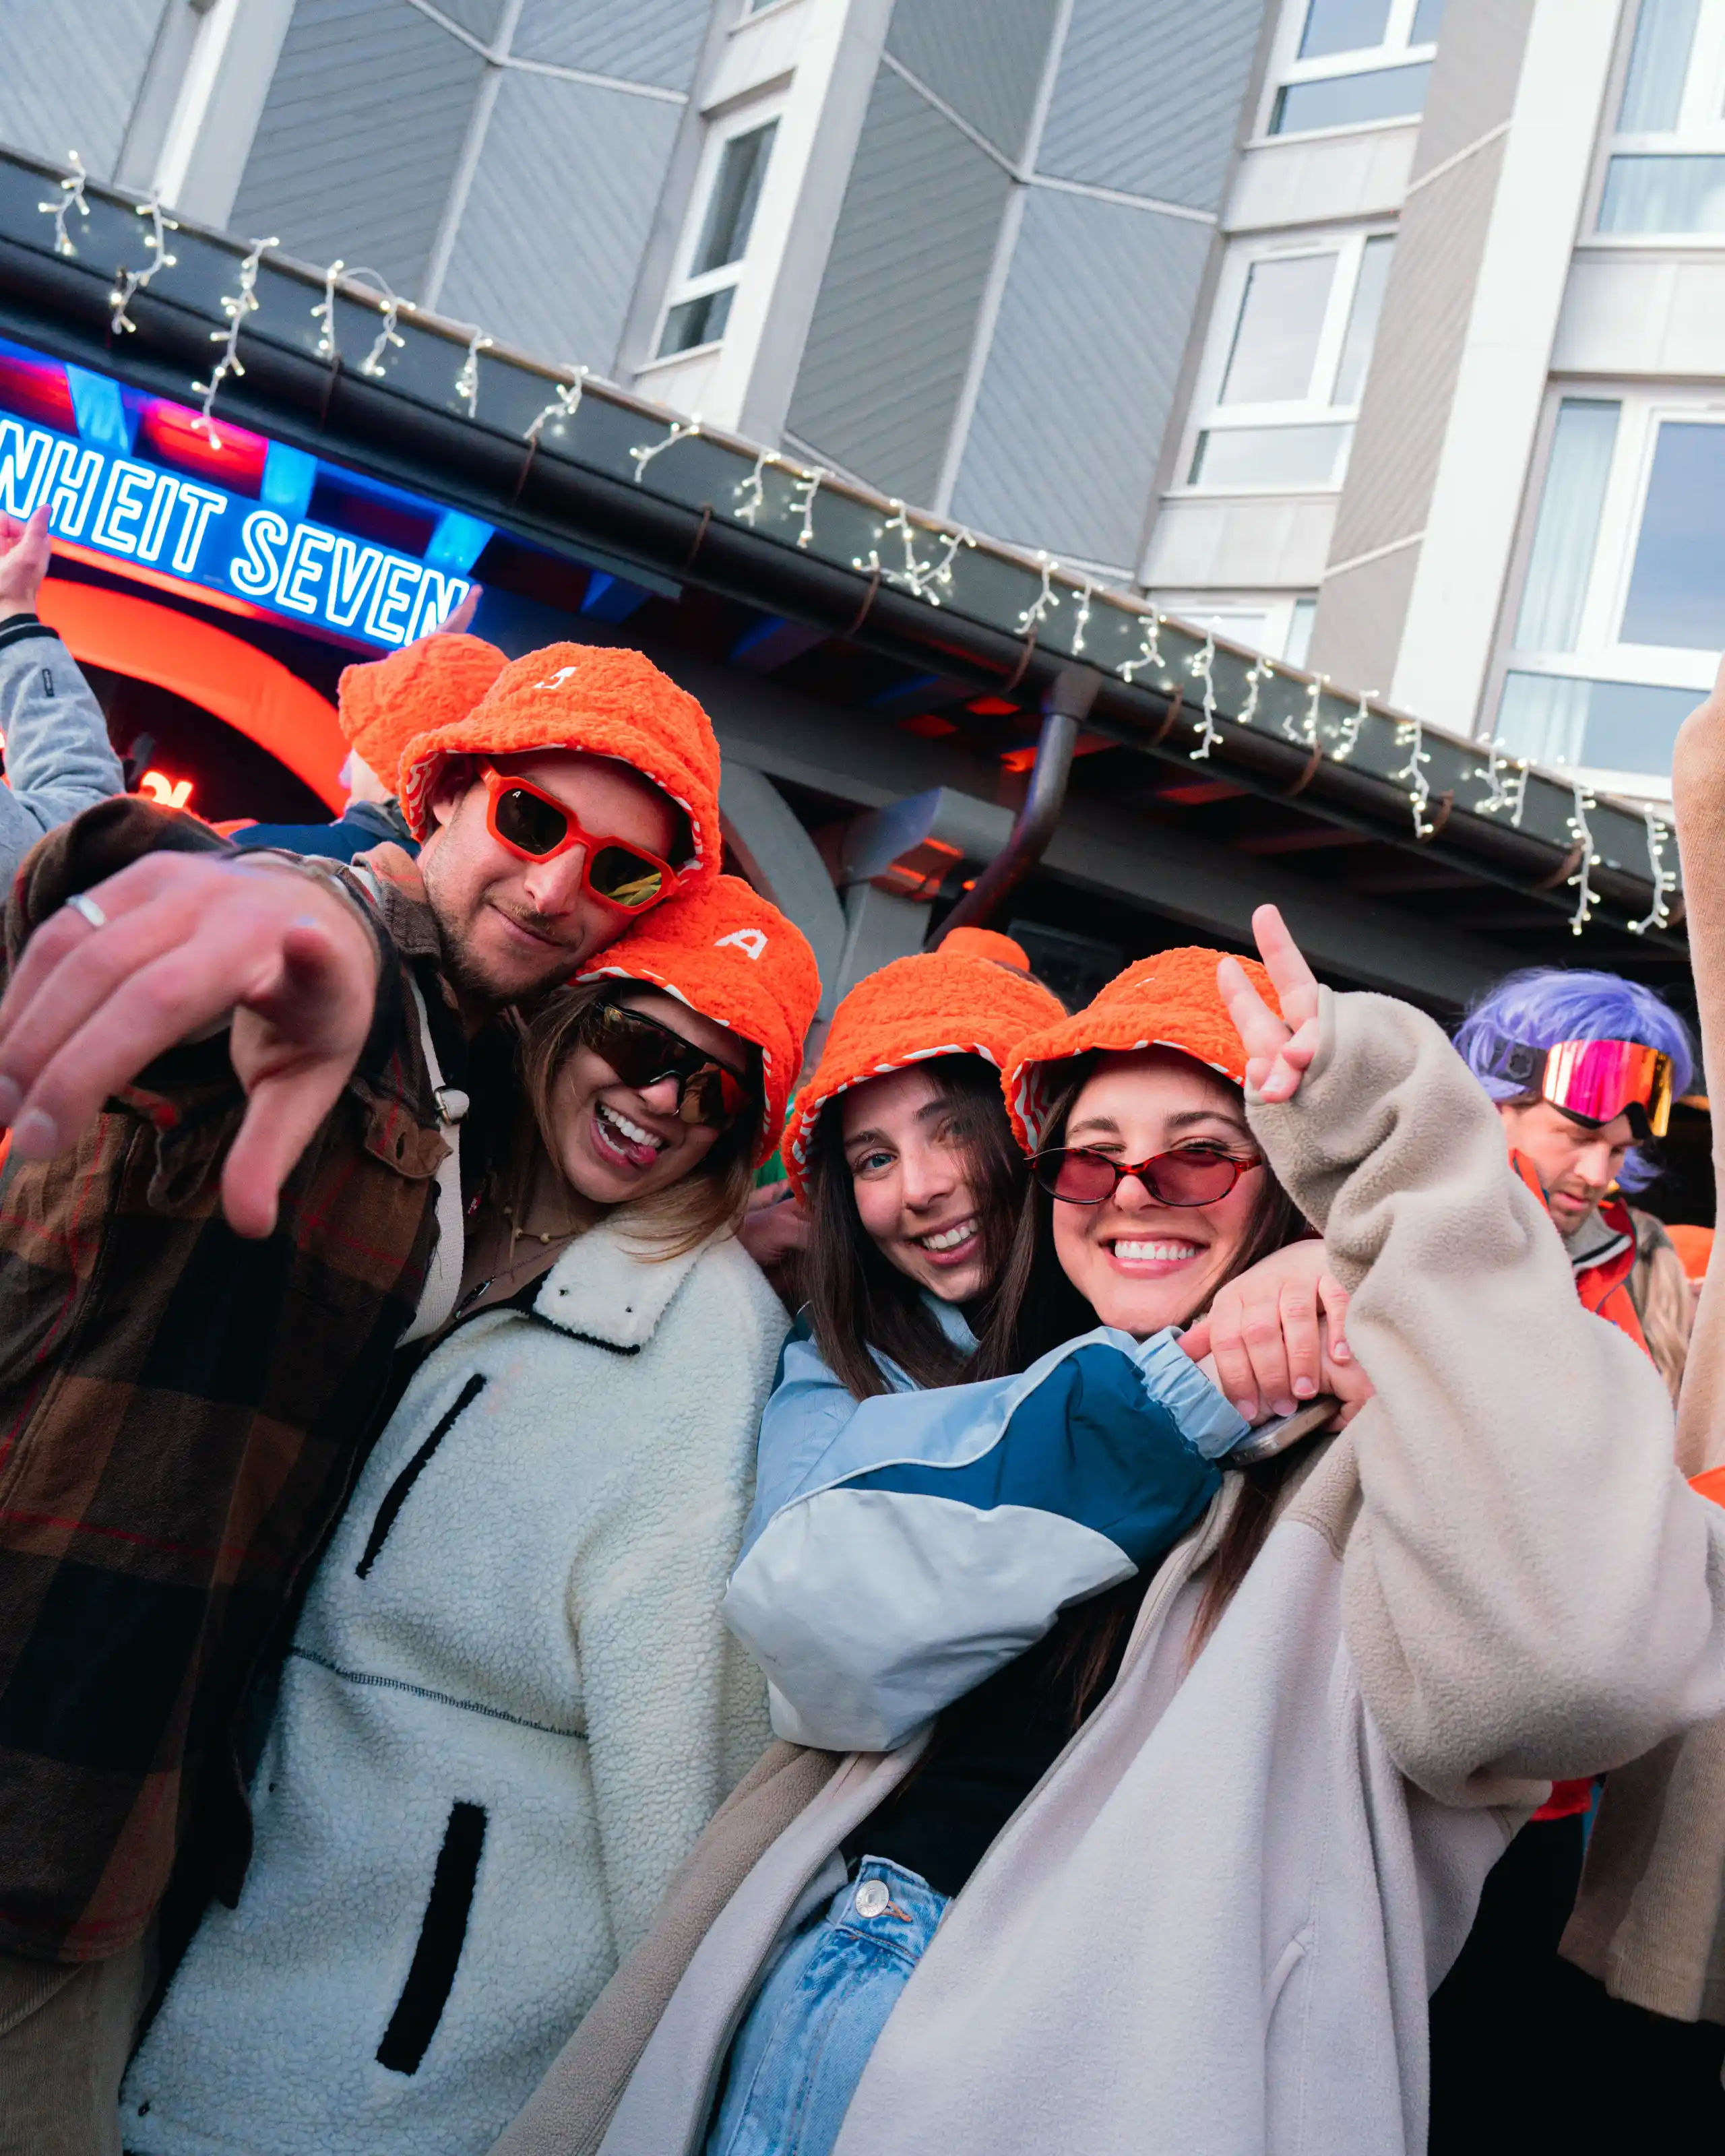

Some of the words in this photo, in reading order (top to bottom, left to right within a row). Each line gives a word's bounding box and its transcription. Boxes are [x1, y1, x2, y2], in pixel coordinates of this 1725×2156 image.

[0, 419, 228, 573] NHEIT
[230, 510, 470, 647] SEVEN
[713, 928, 769, 960] A
